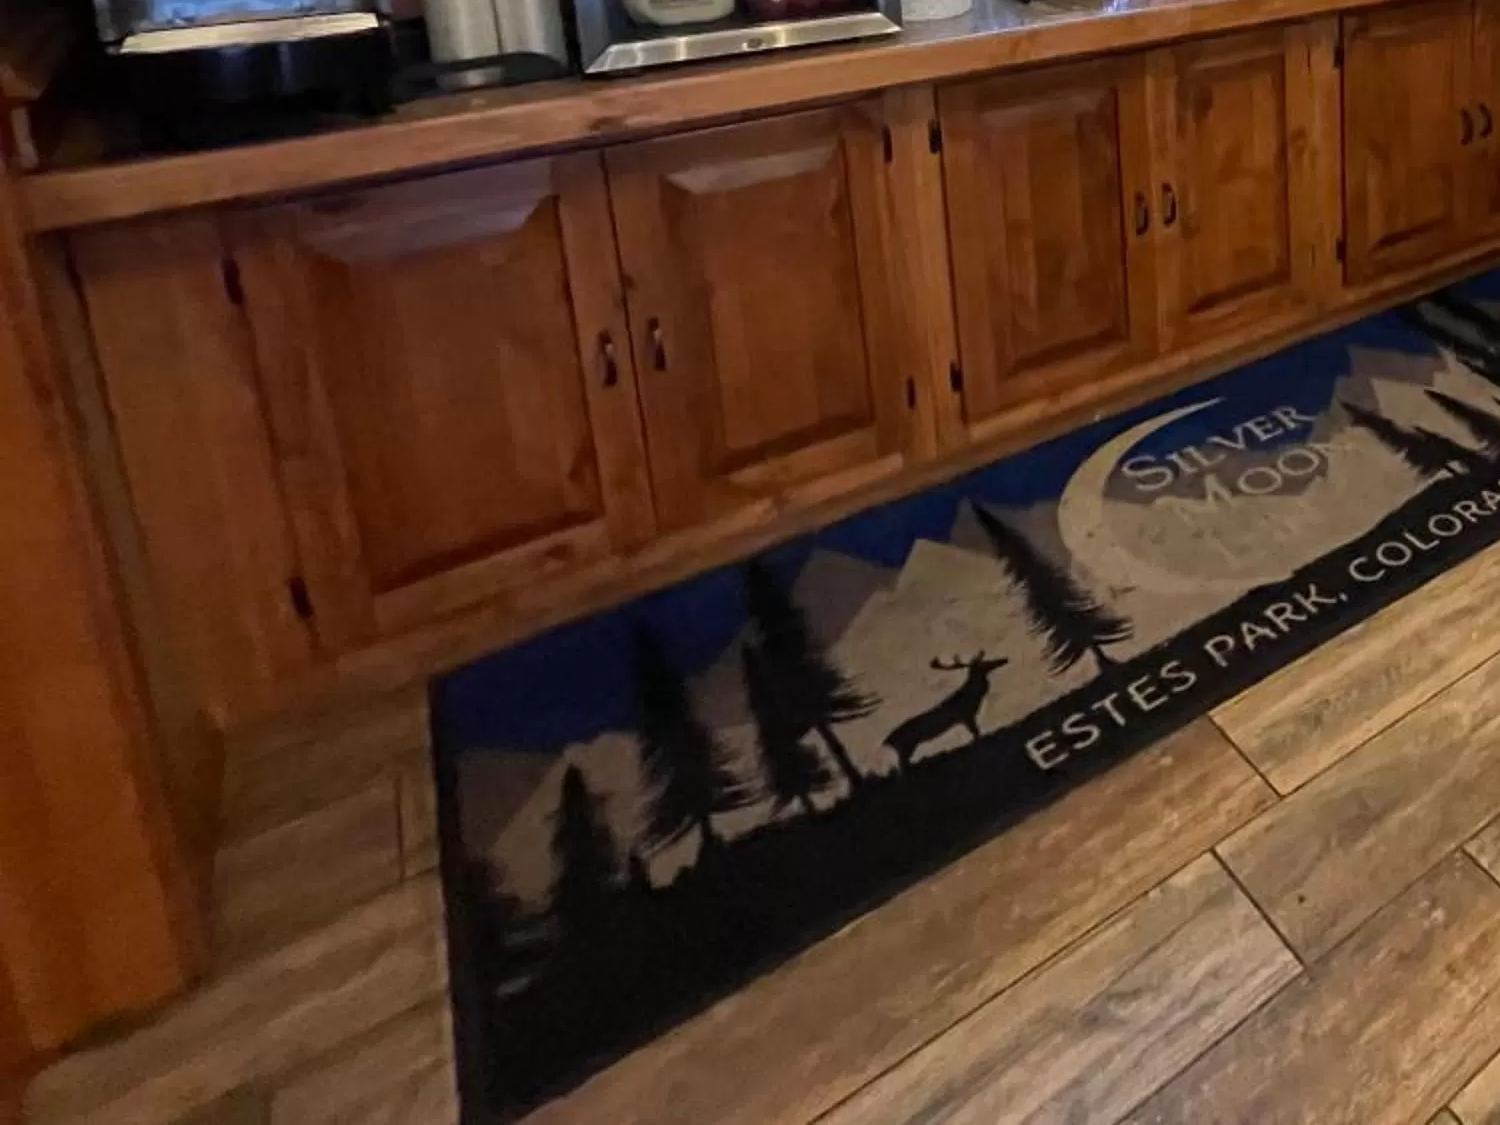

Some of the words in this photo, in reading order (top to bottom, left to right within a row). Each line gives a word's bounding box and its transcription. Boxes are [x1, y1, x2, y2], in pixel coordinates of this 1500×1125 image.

[1121, 406, 1317, 491] SILVER
[1025, 660, 1198, 770] ESTES
[1203, 583, 1348, 667] PARK,
